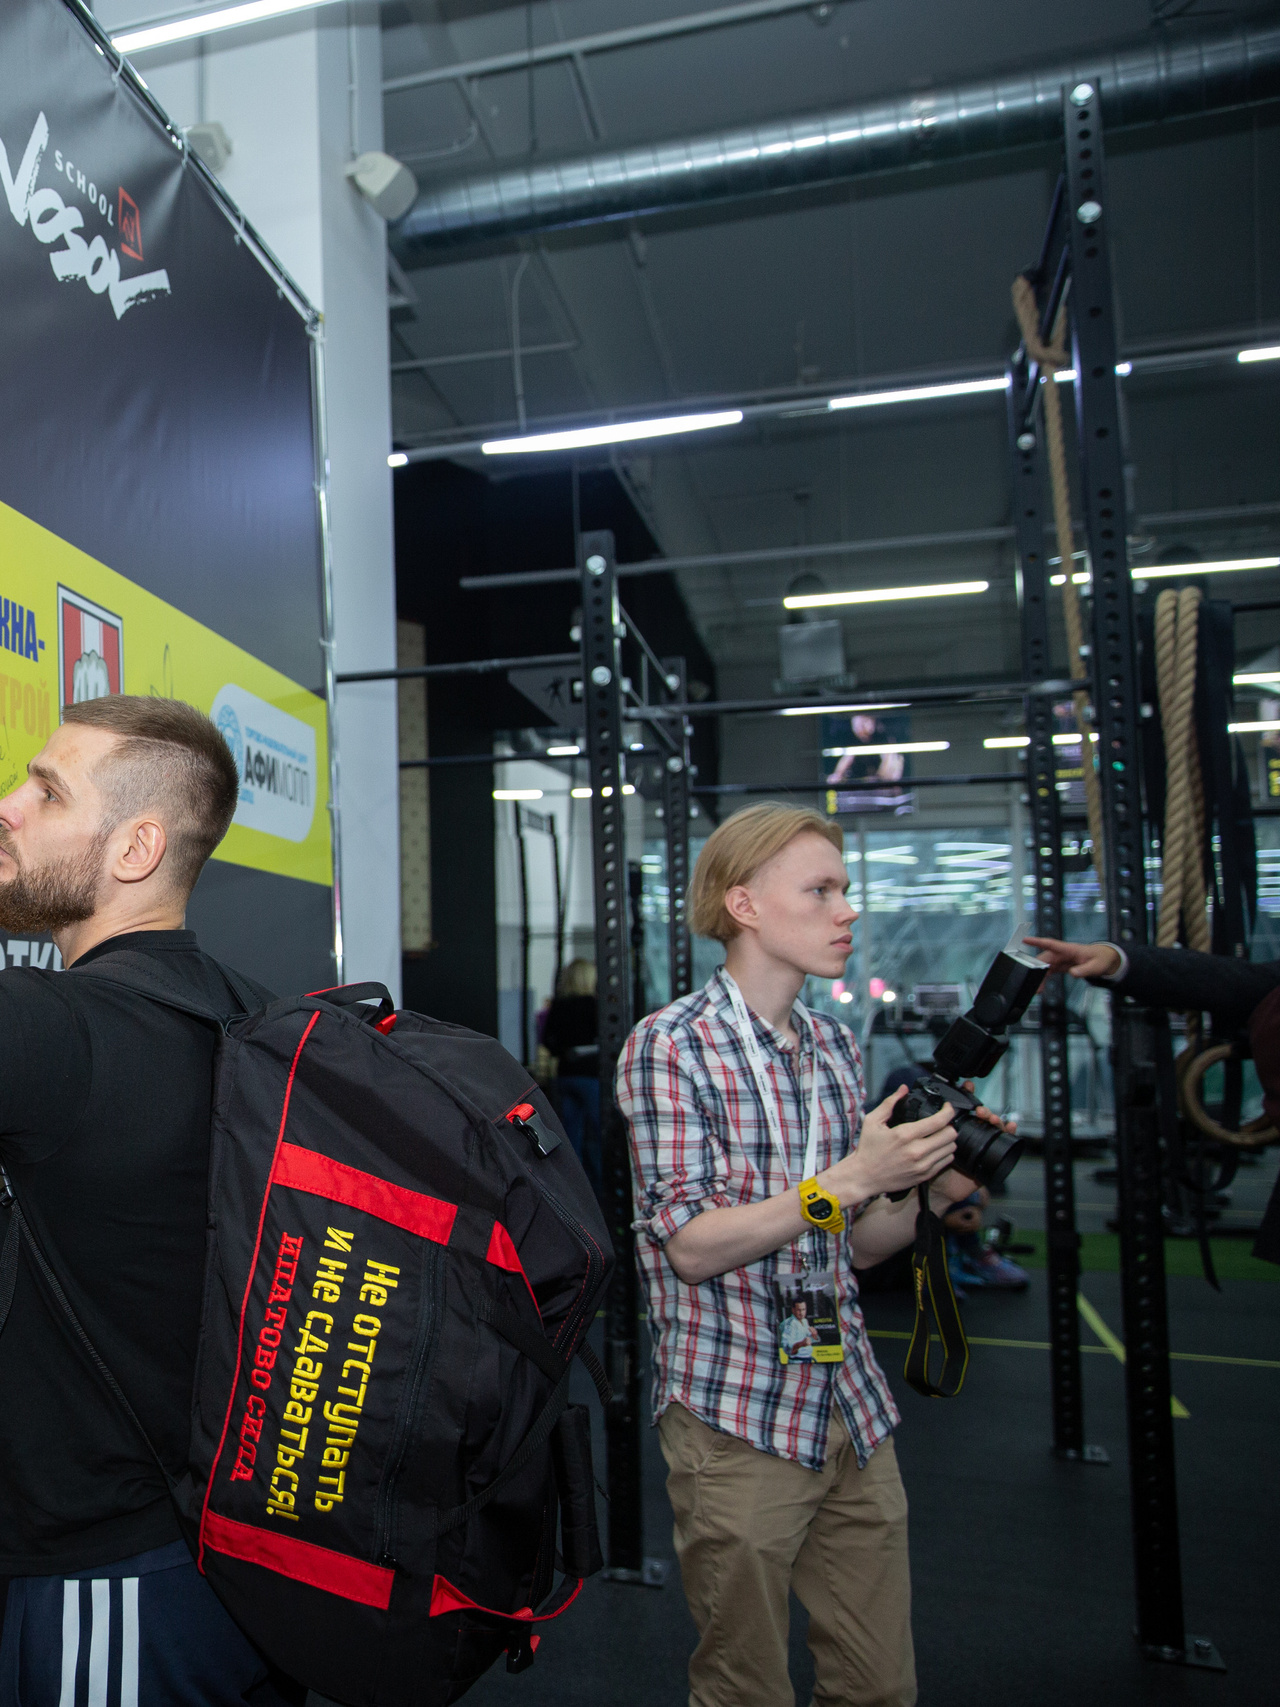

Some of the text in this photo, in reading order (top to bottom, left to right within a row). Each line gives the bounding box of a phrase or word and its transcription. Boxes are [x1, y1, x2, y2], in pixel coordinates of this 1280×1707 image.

[55, 150, 114, 226] SCHOOL
[229, 1231, 305, 1483] ИПАТОВО СИЛА
[265, 1310, 334, 1522] сдаваться!
[314, 1258, 401, 1512] Не отступать
